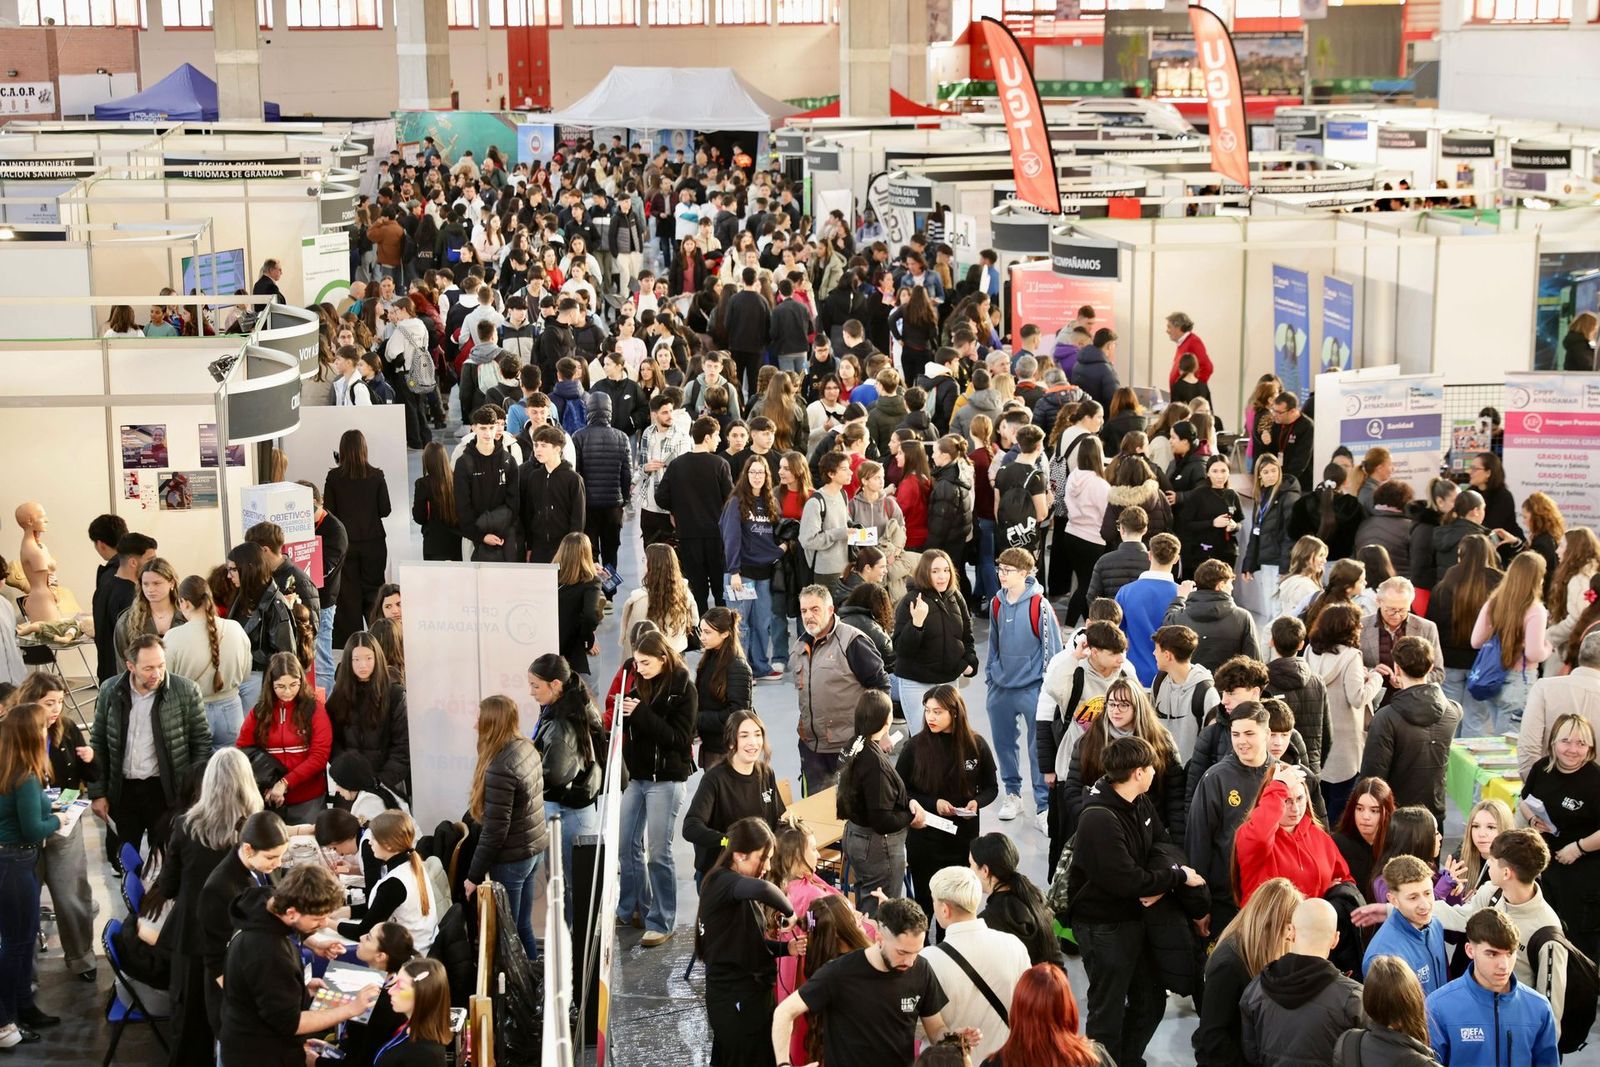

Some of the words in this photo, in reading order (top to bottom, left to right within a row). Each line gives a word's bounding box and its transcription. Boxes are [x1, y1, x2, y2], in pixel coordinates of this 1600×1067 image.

[244, 170, 284, 178] GRANADA
[299, 346, 311, 361] VOY
[1387, 422, 1414, 430] Sanidad
[1545, 419, 1573, 427] Imagen
[270, 510, 311, 522] OBJETIVOS
[1007, 516, 1037, 541] FILA
[288, 547, 293, 558] 8
[1470, 1028, 1484, 1036] EFA
